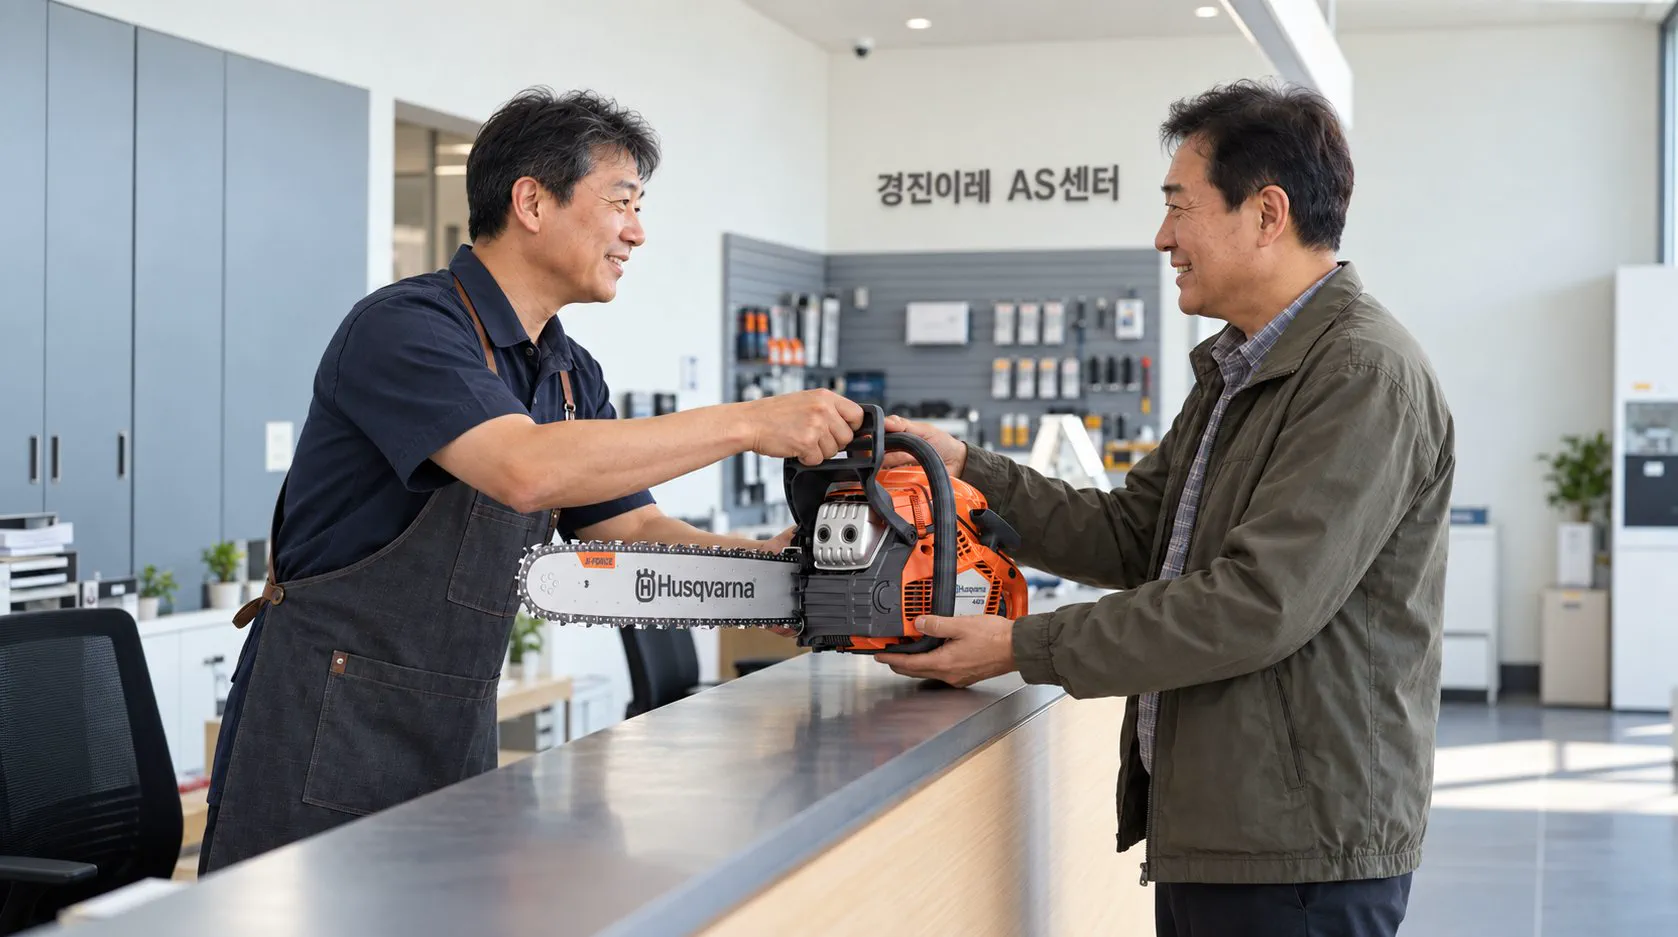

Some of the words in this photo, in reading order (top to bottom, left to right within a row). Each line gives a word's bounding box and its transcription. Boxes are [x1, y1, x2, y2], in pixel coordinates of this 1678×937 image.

[877, 169, 991, 206] 경진이레
[1008, 164, 1120, 202] AS센터
[657, 574, 755, 602] Husqvarna
